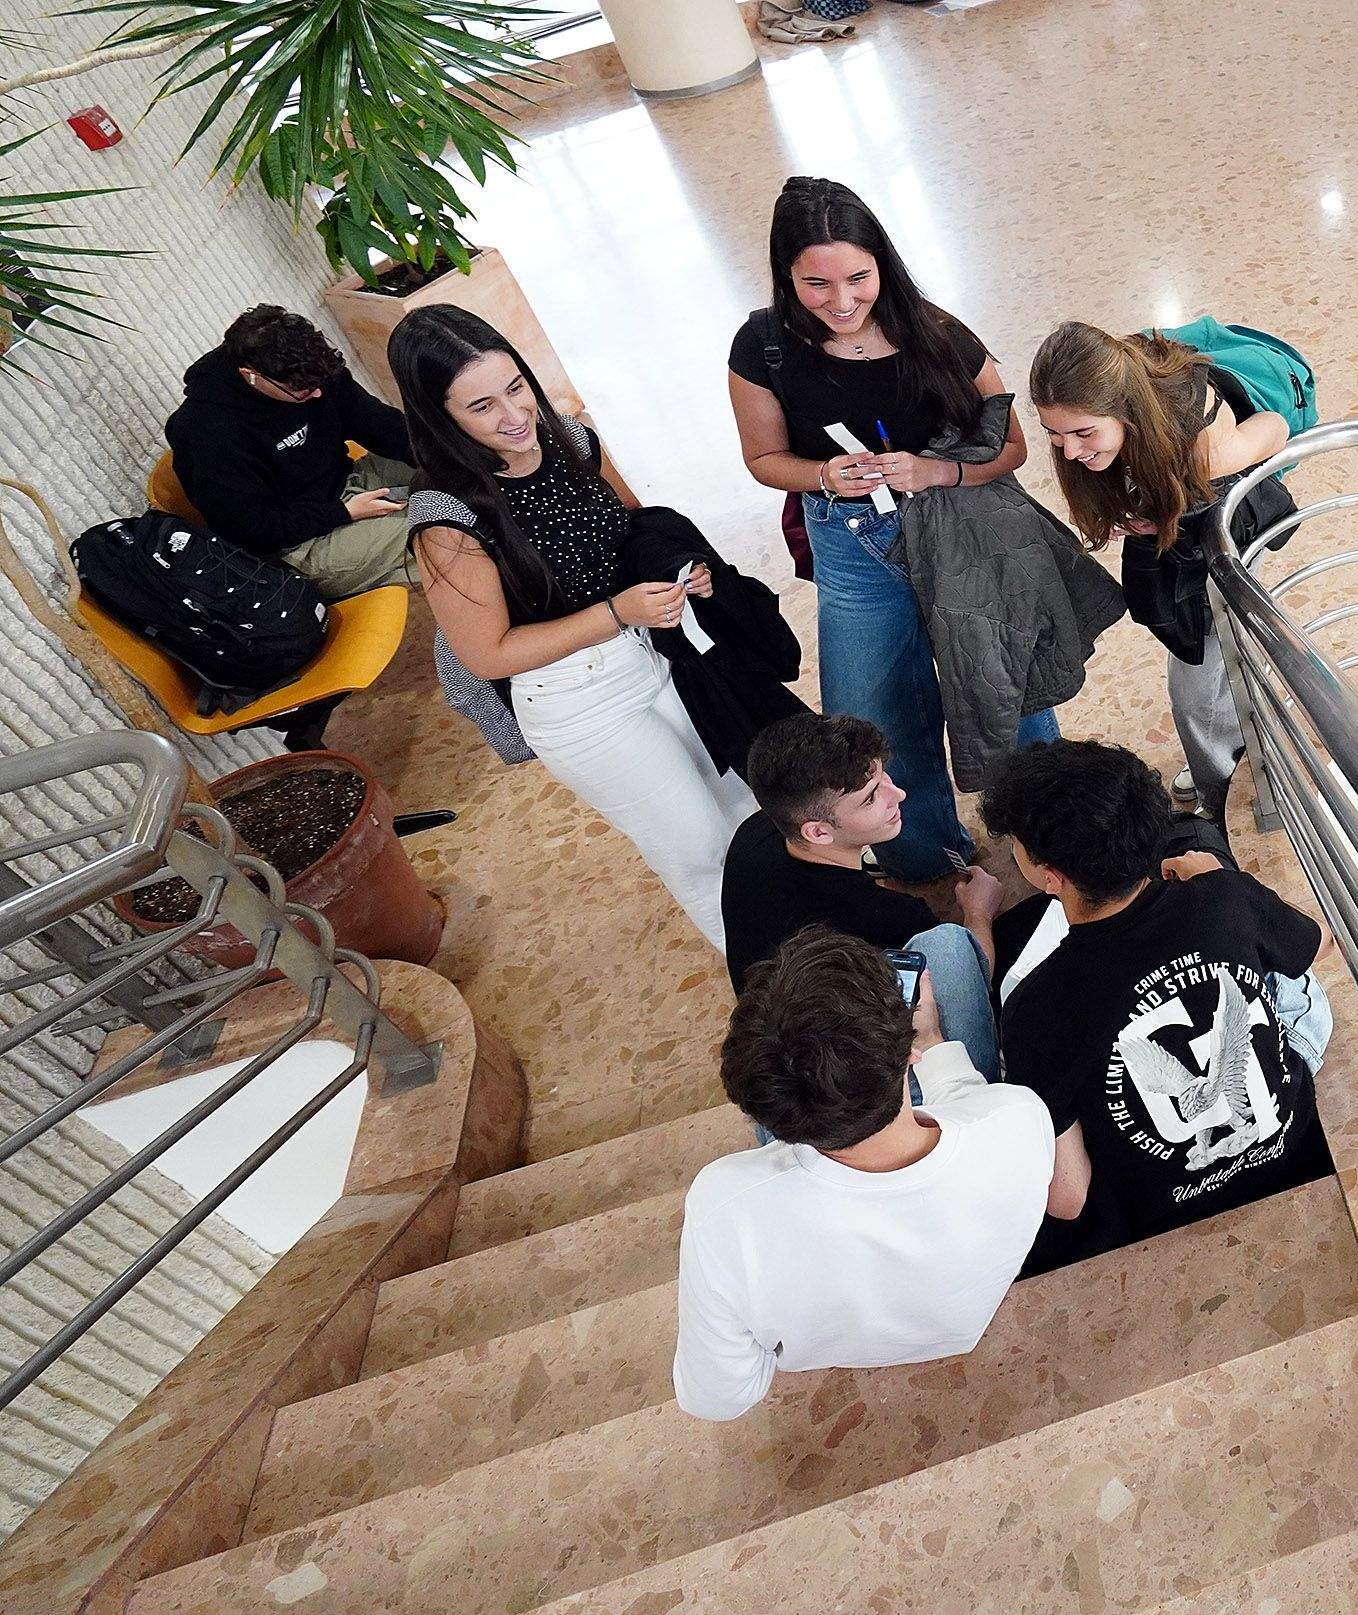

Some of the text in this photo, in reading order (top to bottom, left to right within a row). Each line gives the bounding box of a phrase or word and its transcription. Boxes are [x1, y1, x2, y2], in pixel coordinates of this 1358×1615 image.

[1133, 951, 1202, 995] CRIME TIME
[1235, 964, 1261, 990] FOR
[1128, 990, 1163, 1022] AND
[1107, 1100, 1135, 1131] THE
[1129, 1130, 1175, 1161] PUSH
